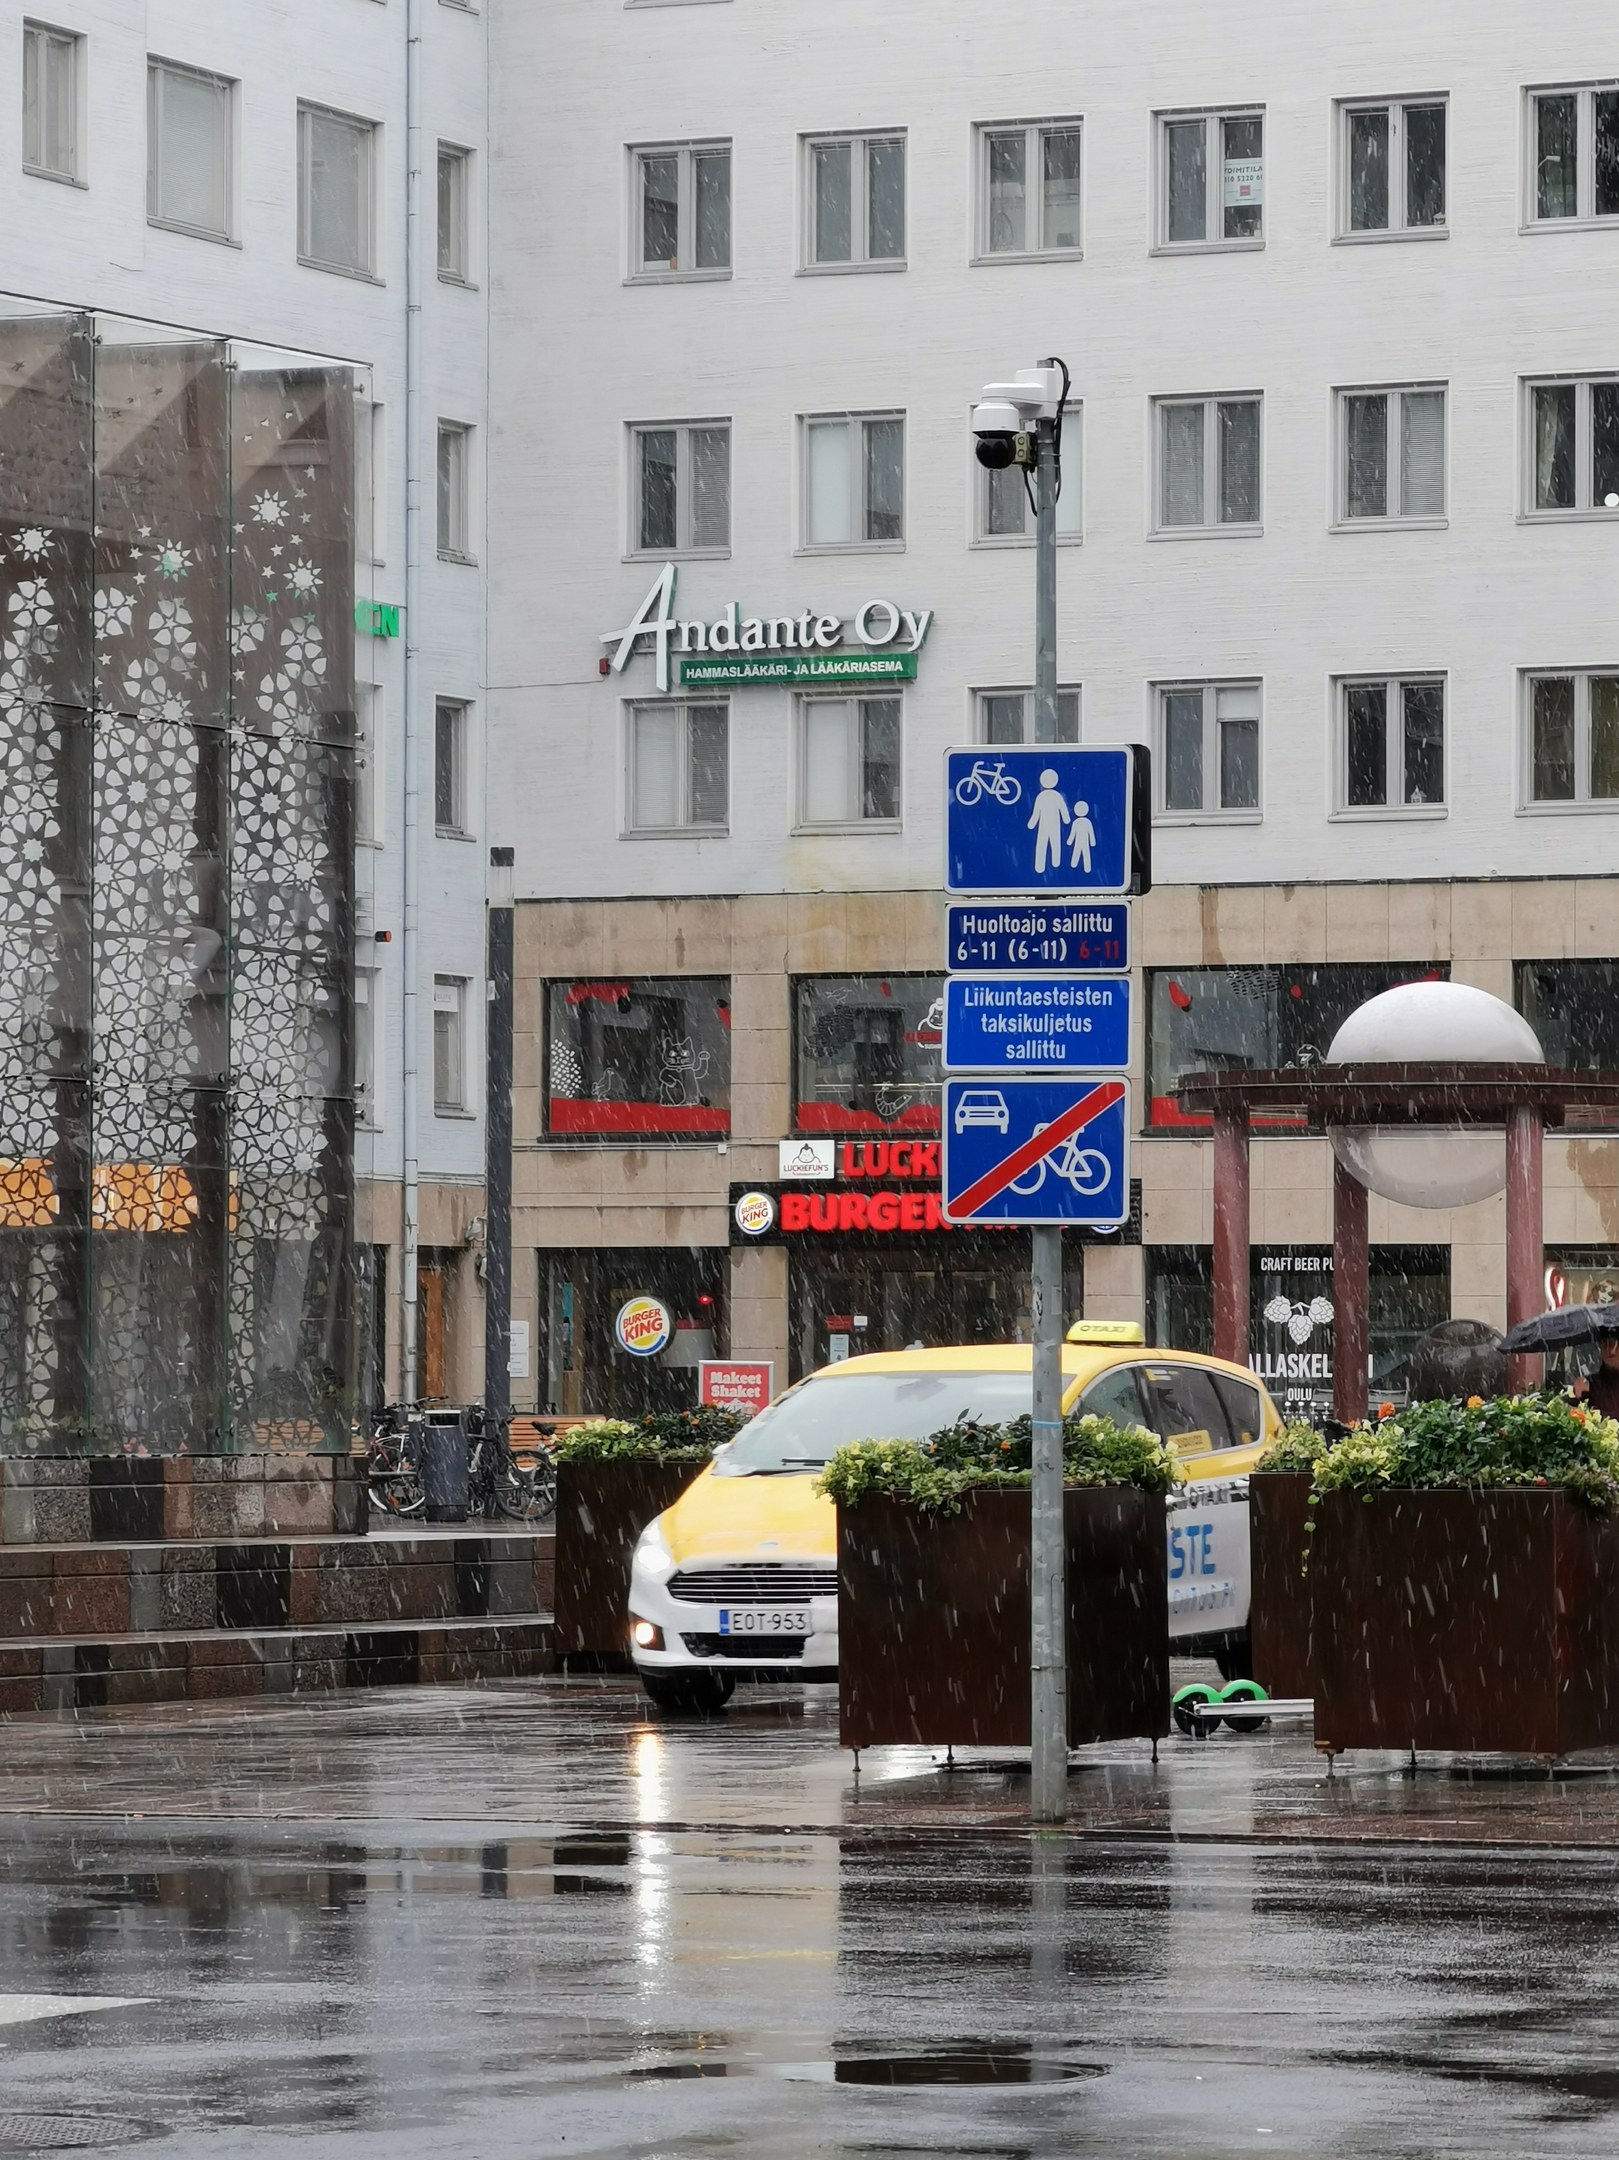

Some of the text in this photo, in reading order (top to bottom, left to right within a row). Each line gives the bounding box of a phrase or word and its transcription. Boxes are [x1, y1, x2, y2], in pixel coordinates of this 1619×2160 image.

[599, 562, 934, 692] Andante Oy
[685, 660, 904, 680] HAMMASLÄÄKÄRI- JA LÄÄKÄRIASEMA
[962, 913, 1113, 936] Huoltoajo sallittu
[957, 941, 997, 961] 6-11
[1008, 938, 1068, 962] (6-11)
[964, 987, 1113, 1007] Liikuntaesteisten
[981, 1013, 1093, 1036] taksikuljetus
[1006, 1040, 1066, 1059] sallittu
[742, 1208, 769, 1224] KING
[1260, 1257, 1293, 1271] CRAFT
[1294, 1257, 1320, 1271] BEER
[623, 1308, 661, 1328] BURGER
[625, 1318, 663, 1343] KING
[710, 1371, 762, 1385] Makeet
[710, 1384, 761, 1399] Shaket
[1287, 1388, 1312, 1401] OULU
